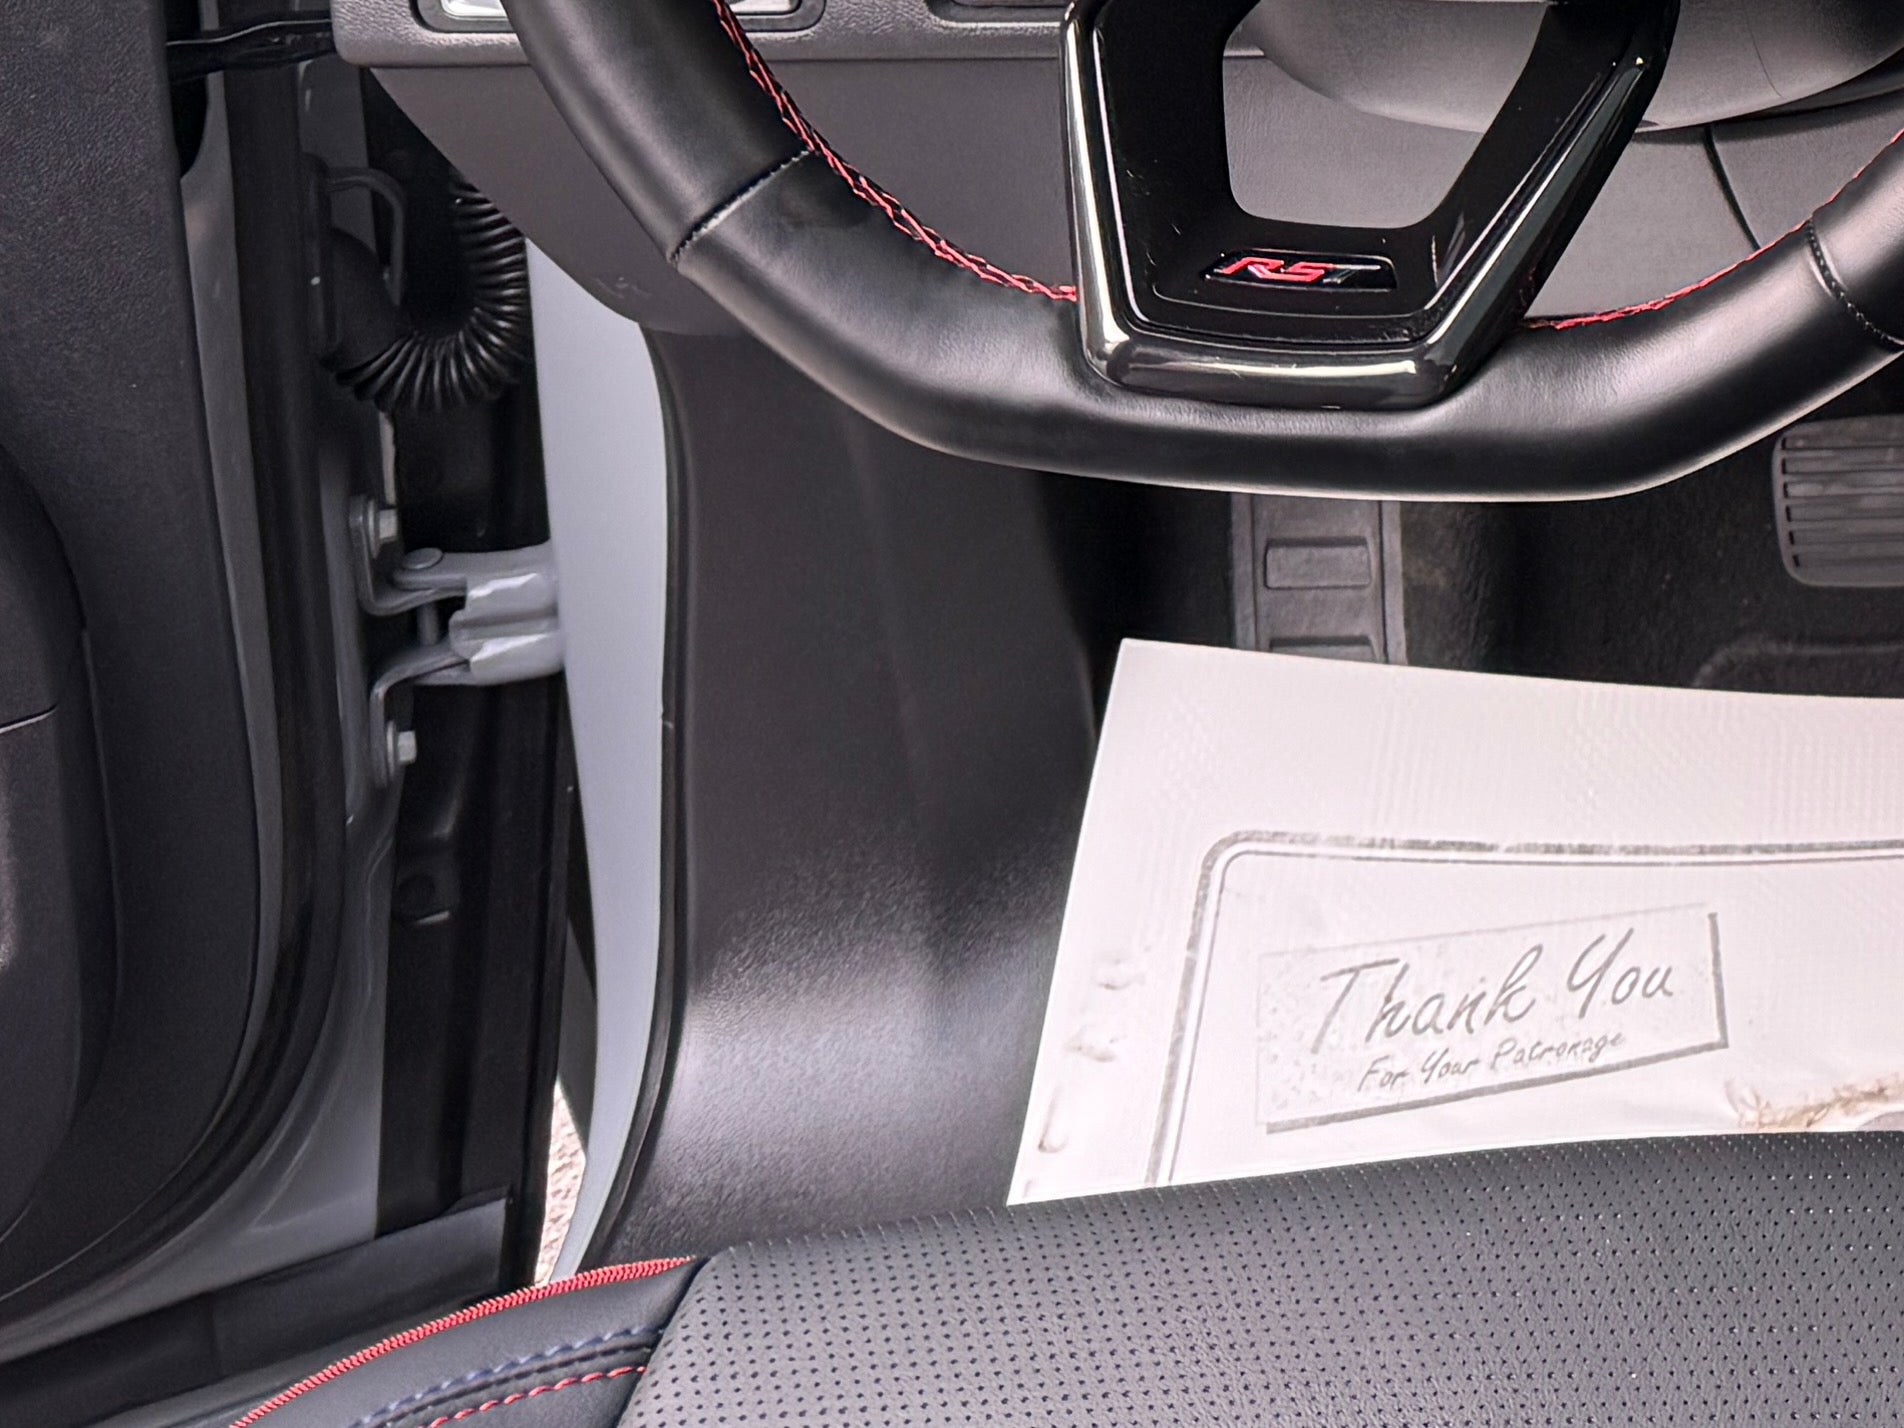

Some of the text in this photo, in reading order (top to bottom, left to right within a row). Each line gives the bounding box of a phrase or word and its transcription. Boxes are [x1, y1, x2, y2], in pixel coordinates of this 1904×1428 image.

[1220, 254, 1336, 284] RS
[1313, 925, 1676, 1057] Thank You
[1360, 1029, 1627, 1095] For Your Patronage
